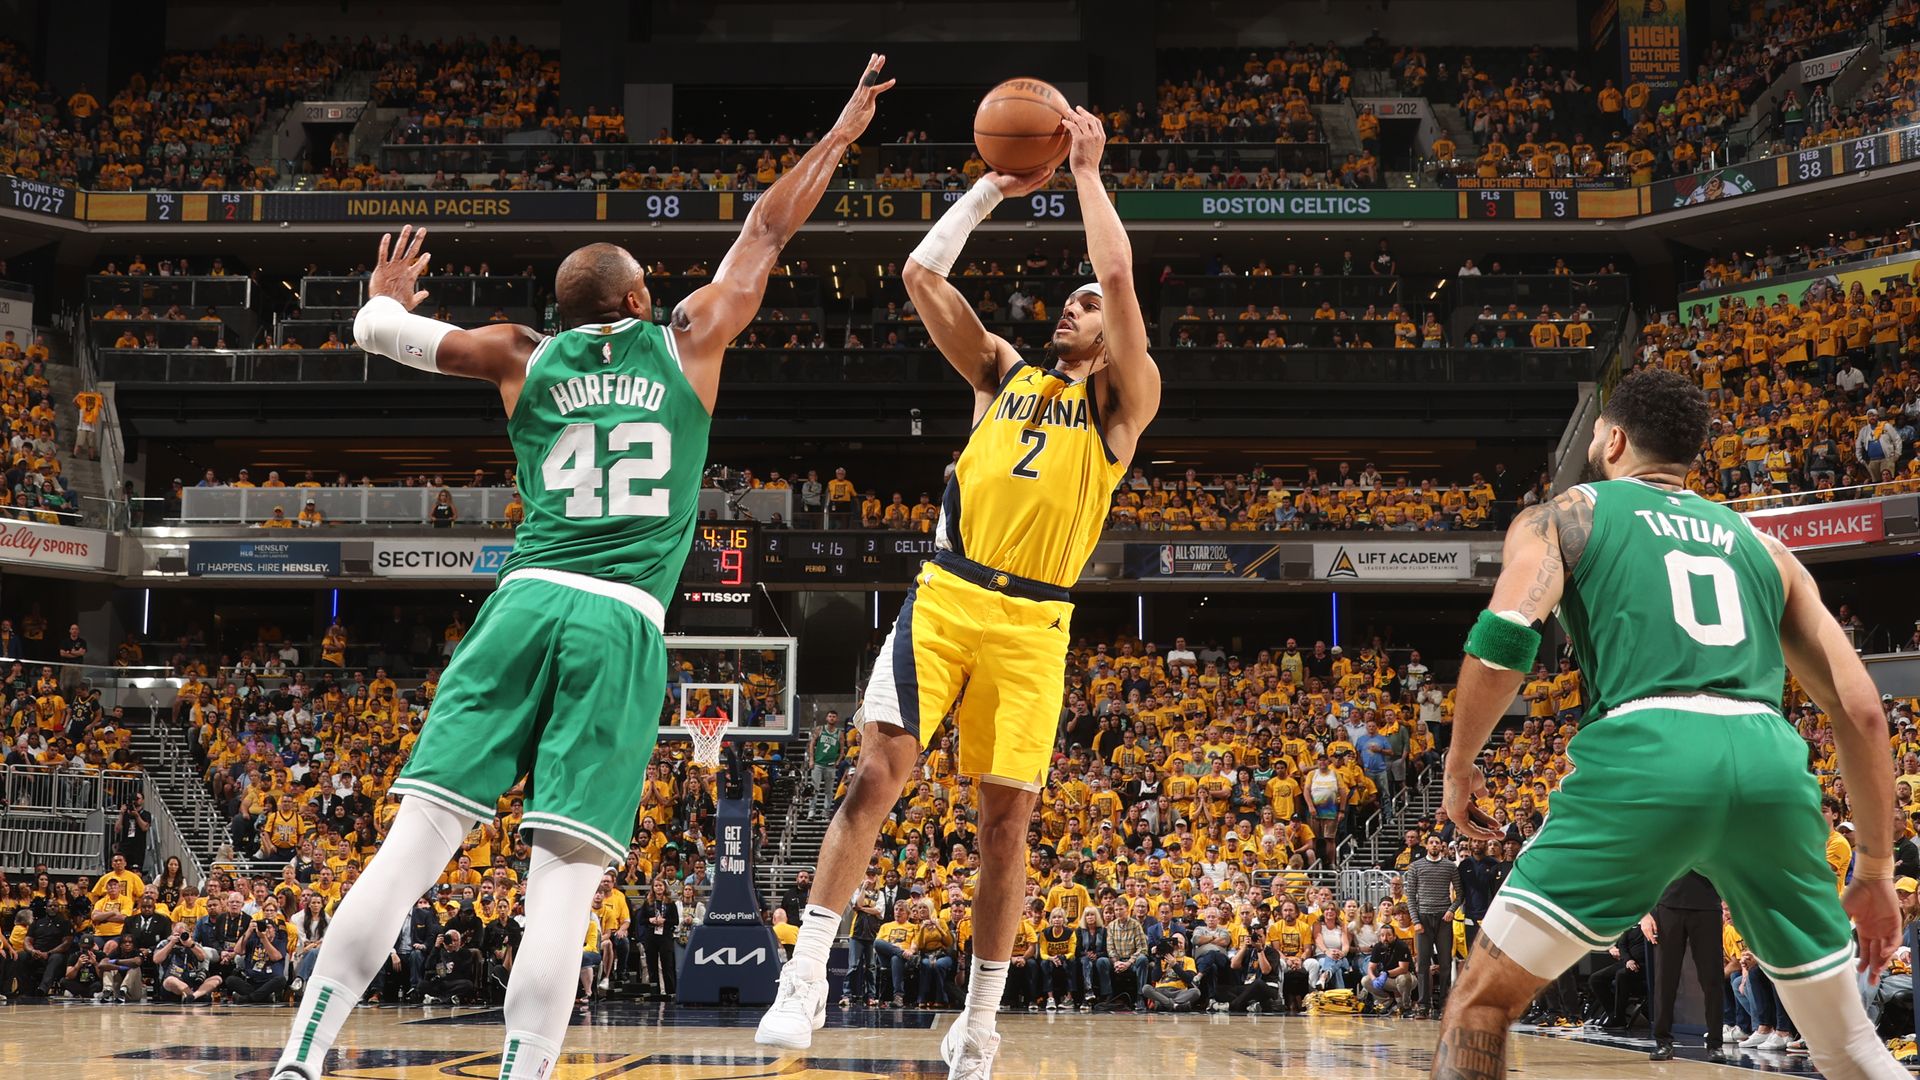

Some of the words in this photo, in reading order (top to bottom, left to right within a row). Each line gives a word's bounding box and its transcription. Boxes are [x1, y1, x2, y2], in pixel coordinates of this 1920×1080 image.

[1628, 26, 1680, 47] HIGH
[1629, 48, 1680, 61] OCTANE
[1630, 62, 1680, 73] DRUMLINE
[1804, 63, 1825, 78] 203
[306, 107, 323, 118] 231
[1397, 103, 1417, 115] 202
[1855, 138, 1875, 150] AST
[1800, 150, 1819, 161] REB
[1854, 149, 1875, 168] 21
[1800, 162, 1822, 180] 38
[11, 180, 50, 197] 3-POINT
[52, 187, 65, 198] FG
[1457, 178, 1479, 188] HIGH
[1482, 178, 1521, 188] OCTANE
[1524, 178, 1573, 188] DRUMLINE
[14, 190, 63, 214] 10/27
[156, 194, 174, 203] TOL
[222, 194, 240, 203] FLS
[743, 192, 762, 202] SH
[1481, 191, 1500, 200] FLS
[1549, 191, 1568, 200] TOL
[159, 206, 170, 220] 2
[225, 205, 236, 220] 2
[348, 199, 429, 216] INDIANA
[435, 199, 510, 216] PACERS
[646, 195, 680, 218] 98
[834, 194, 895, 218] 4:16
[1031, 194, 1066, 218] 95
[1203, 198, 1285, 214] BOSTON
[1290, 197, 1371, 214] CELTICS
[1486, 202, 1497, 217] 3
[1554, 202, 1565, 217] 3
[549, 373, 666, 416] HORFORD
[994, 391, 1089, 431] INDIANA
[1011, 428, 1048, 479] 2
[541, 422, 672, 518] 42
[1635, 509, 1735, 555] TATUM
[1793, 525, 1803, 537] N
[1807, 515, 1873, 537] SHAKE
[703, 529, 748, 548] 4:16
[770, 540, 777, 551] 2
[868, 540, 875, 551] 3
[43, 538, 88, 557] SPORTS
[254, 544, 289, 552] HENSLEY
[811, 542, 843, 556] 4:16
[895, 541, 940, 553] CELTI
[1210, 546, 1228, 560] 2024
[378, 551, 474, 568] SECTION
[479, 551, 510, 568] 127
[1358, 552, 1386, 564] LIFT
[1389, 552, 1458, 564] ACADEMY
[197, 563, 205, 572] IT
[207, 563, 255, 572] HAPPENS.
[258, 563, 280, 572] HIRE
[282, 563, 330, 573] HENSLEY.
[721, 550, 742, 585] 9
[805, 565, 827, 573] PERIOD
[836, 564, 843, 574] 4
[1192, 563, 1212, 571] INDY
[702, 592, 751, 603] TISSOT
[1664, 549, 1747, 647] 0
[822, 743, 831, 753] 7
[725, 826, 741, 840] GET
[725, 841, 741, 856] THE
[728, 857, 745, 874] App
[709, 912, 736, 921] Google
[737, 911, 755, 920] Pixel
[694, 947, 766, 966] KIA
